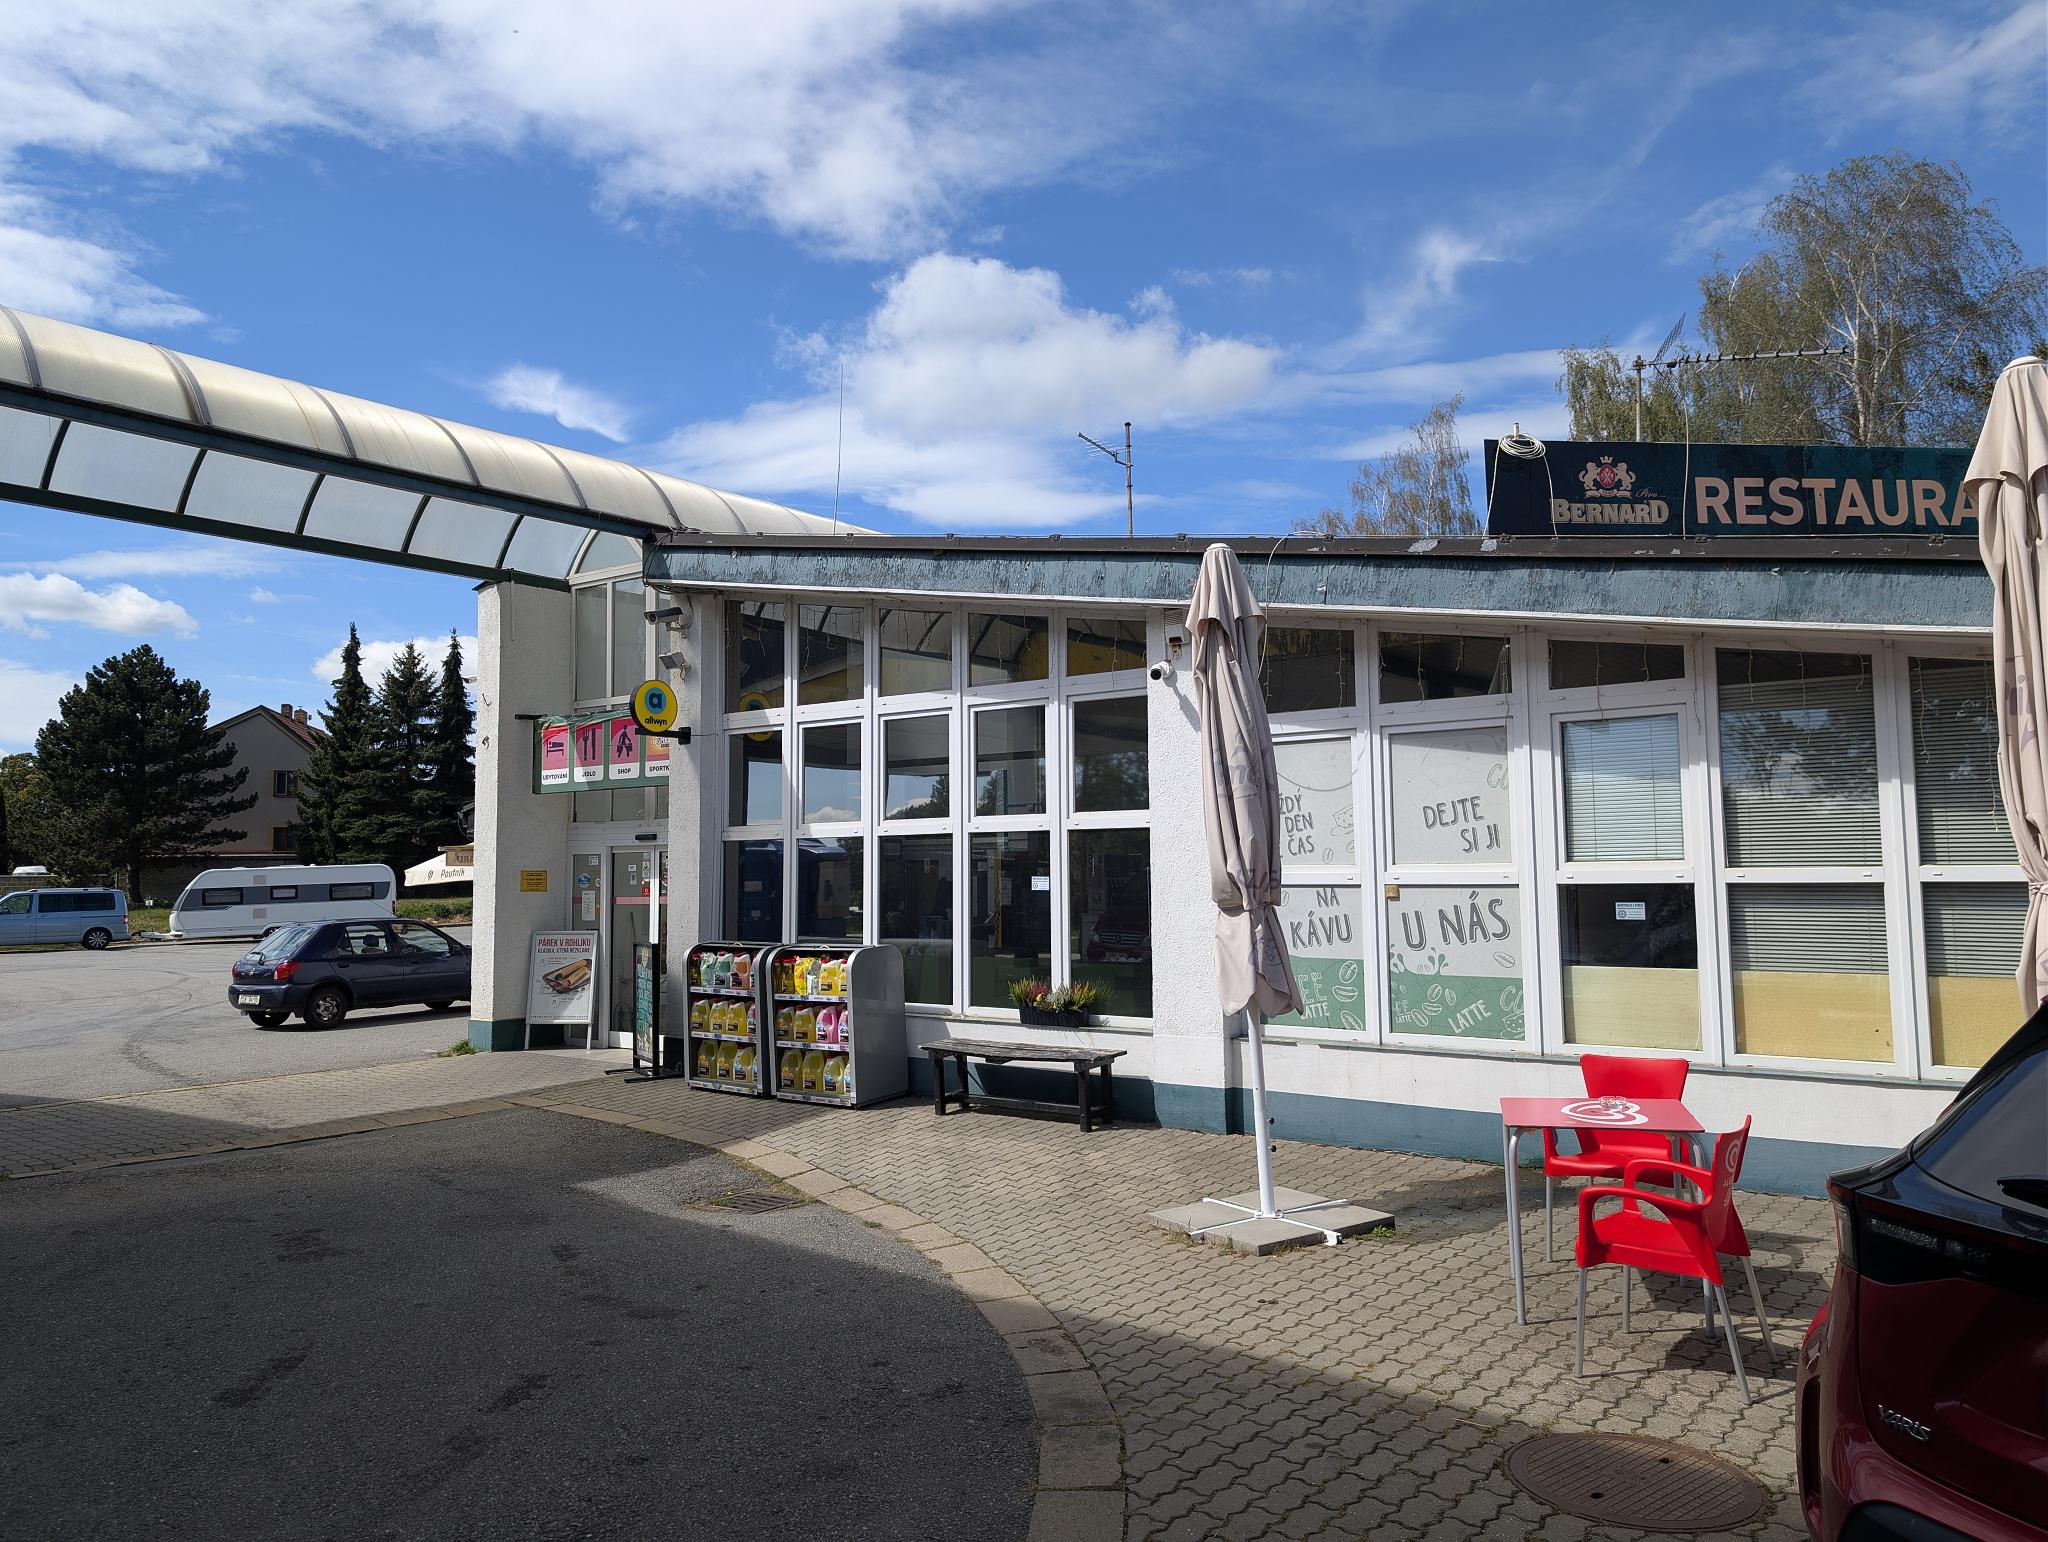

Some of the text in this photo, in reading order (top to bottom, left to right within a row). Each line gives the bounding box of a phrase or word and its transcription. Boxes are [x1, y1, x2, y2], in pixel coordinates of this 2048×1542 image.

[1549, 498, 1669, 525] BERNARD
[1694, 476, 1979, 526] RESTAURA
[644, 716, 668, 727] allwyn
[1279, 787, 1303, 815] ŽDÝ
[1422, 795, 1486, 829] DEJTE
[1284, 811, 1314, 835] DEN
[1287, 834, 1316, 857] ČAS
[1460, 823, 1501, 854] SI JI
[1316, 887, 1341, 908] NA
[1289, 910, 1353, 949] KÁVU
[1401, 890, 1511, 951] U NÁS
[538, 937, 559, 947] PÁREK
[560, 939, 564, 947] V
[1447, 999, 1493, 1034] LATTE
